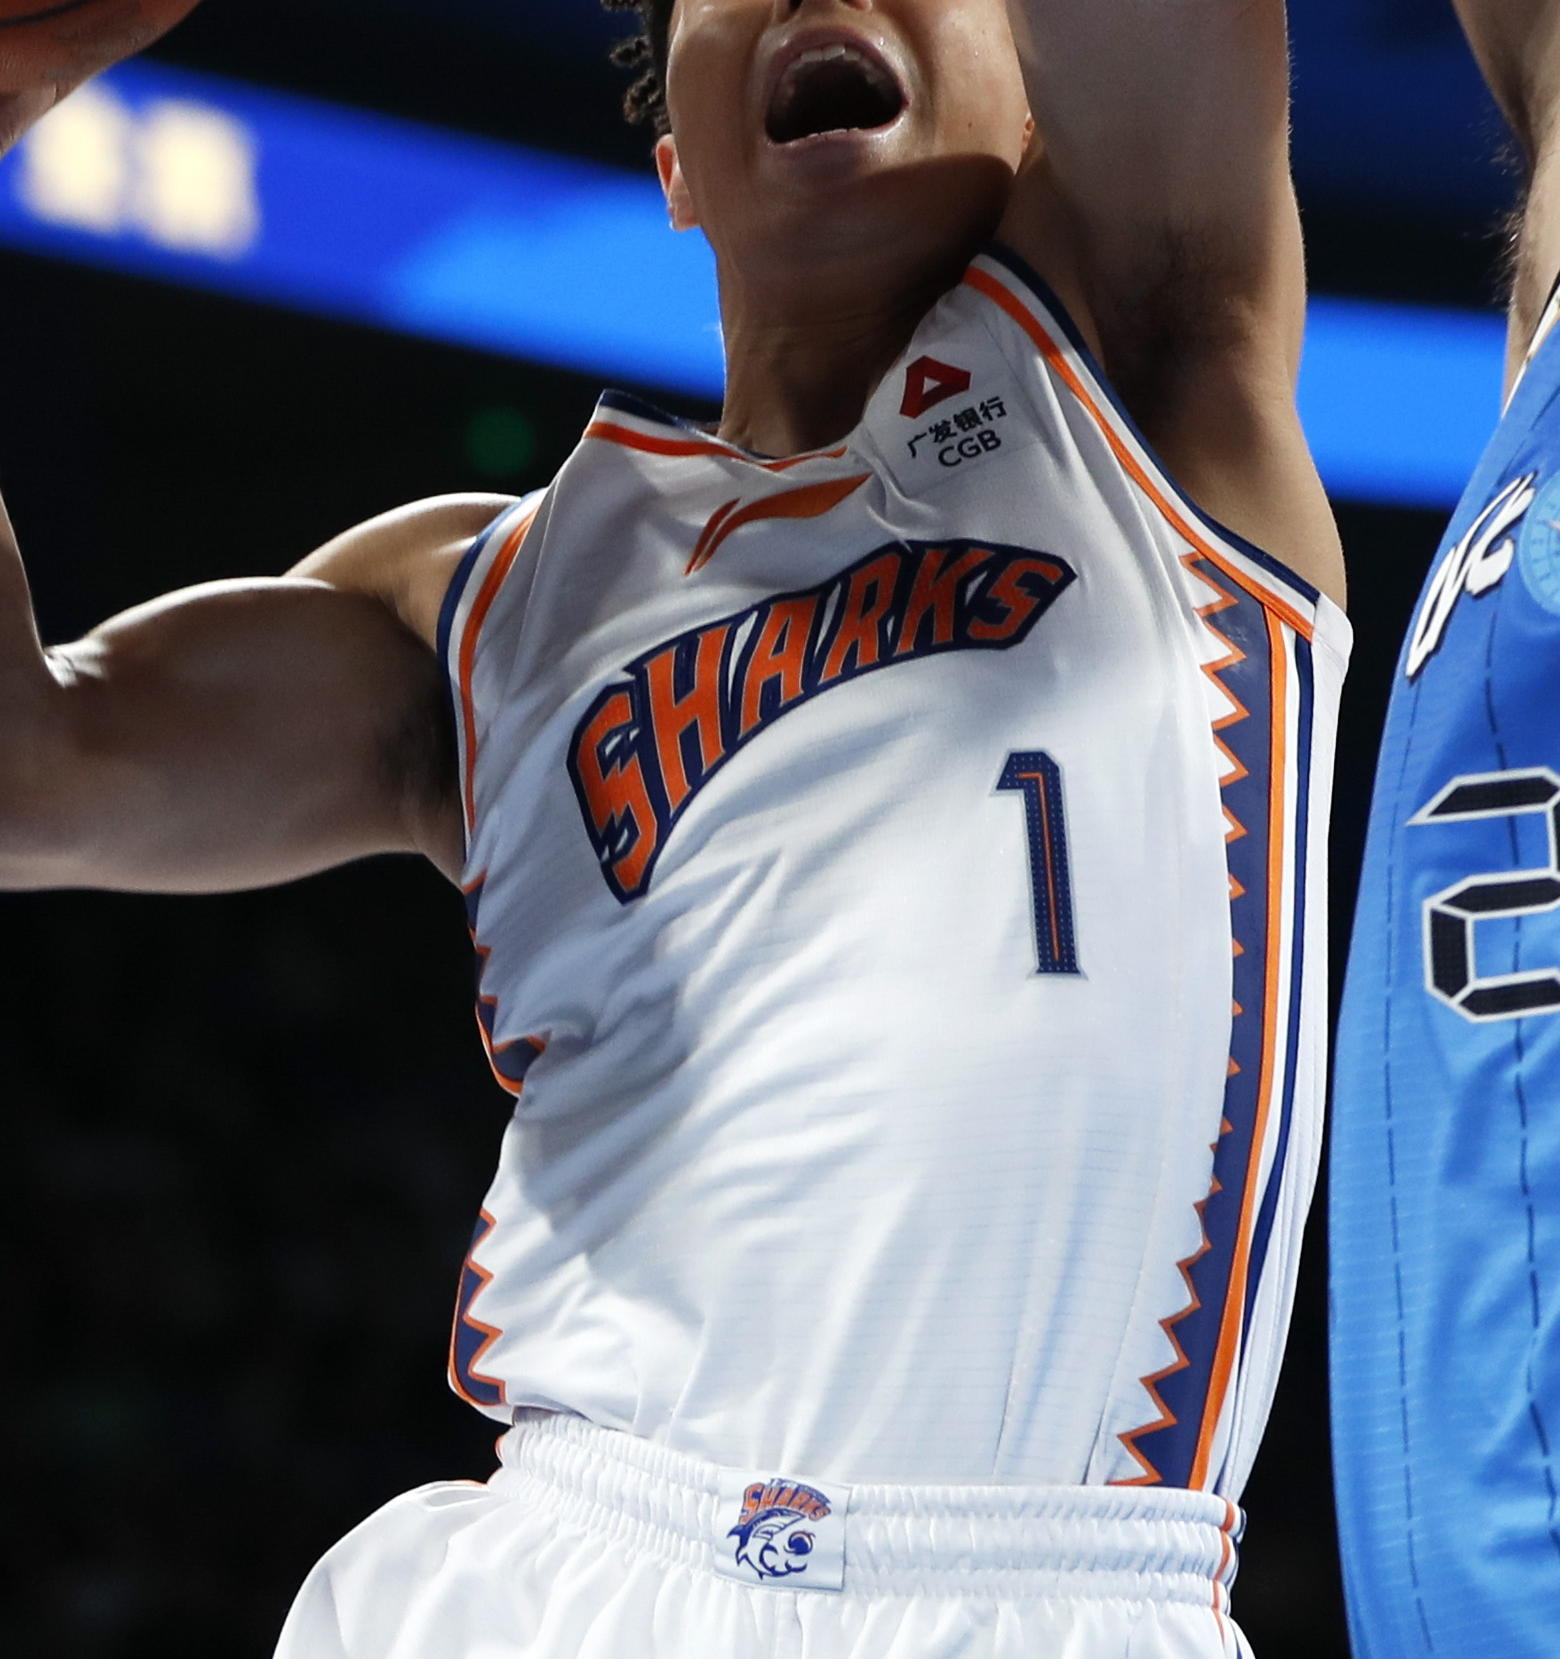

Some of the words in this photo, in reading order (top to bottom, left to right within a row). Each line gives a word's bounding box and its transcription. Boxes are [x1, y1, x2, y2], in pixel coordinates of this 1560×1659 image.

[907, 396, 1007, 459] 广发银行
[937, 428, 1002, 468] CGB
[566, 539, 1077, 905] SHARKS
[990, 750, 1088, 980] 1
